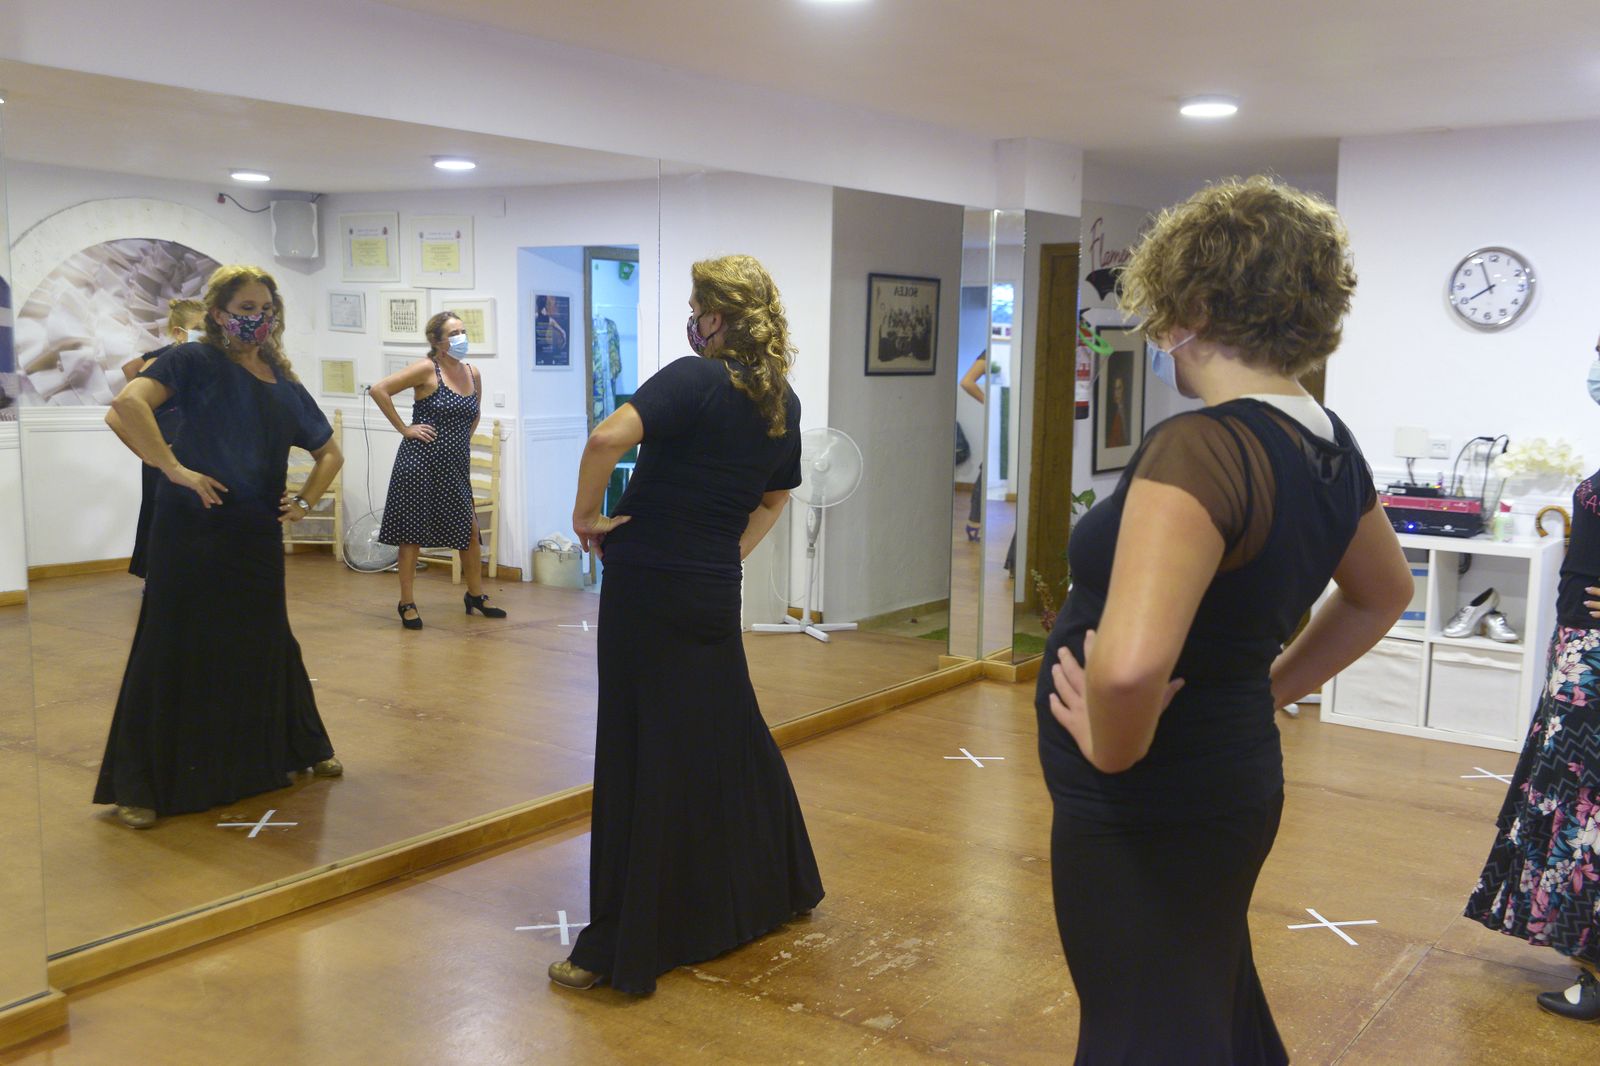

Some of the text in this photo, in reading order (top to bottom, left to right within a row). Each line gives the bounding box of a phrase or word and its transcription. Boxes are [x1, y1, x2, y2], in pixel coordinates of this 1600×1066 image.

[1470, 308, 1477, 316] 7
[1483, 312, 1492, 320] 6
[1499, 308, 1507, 316] 5
